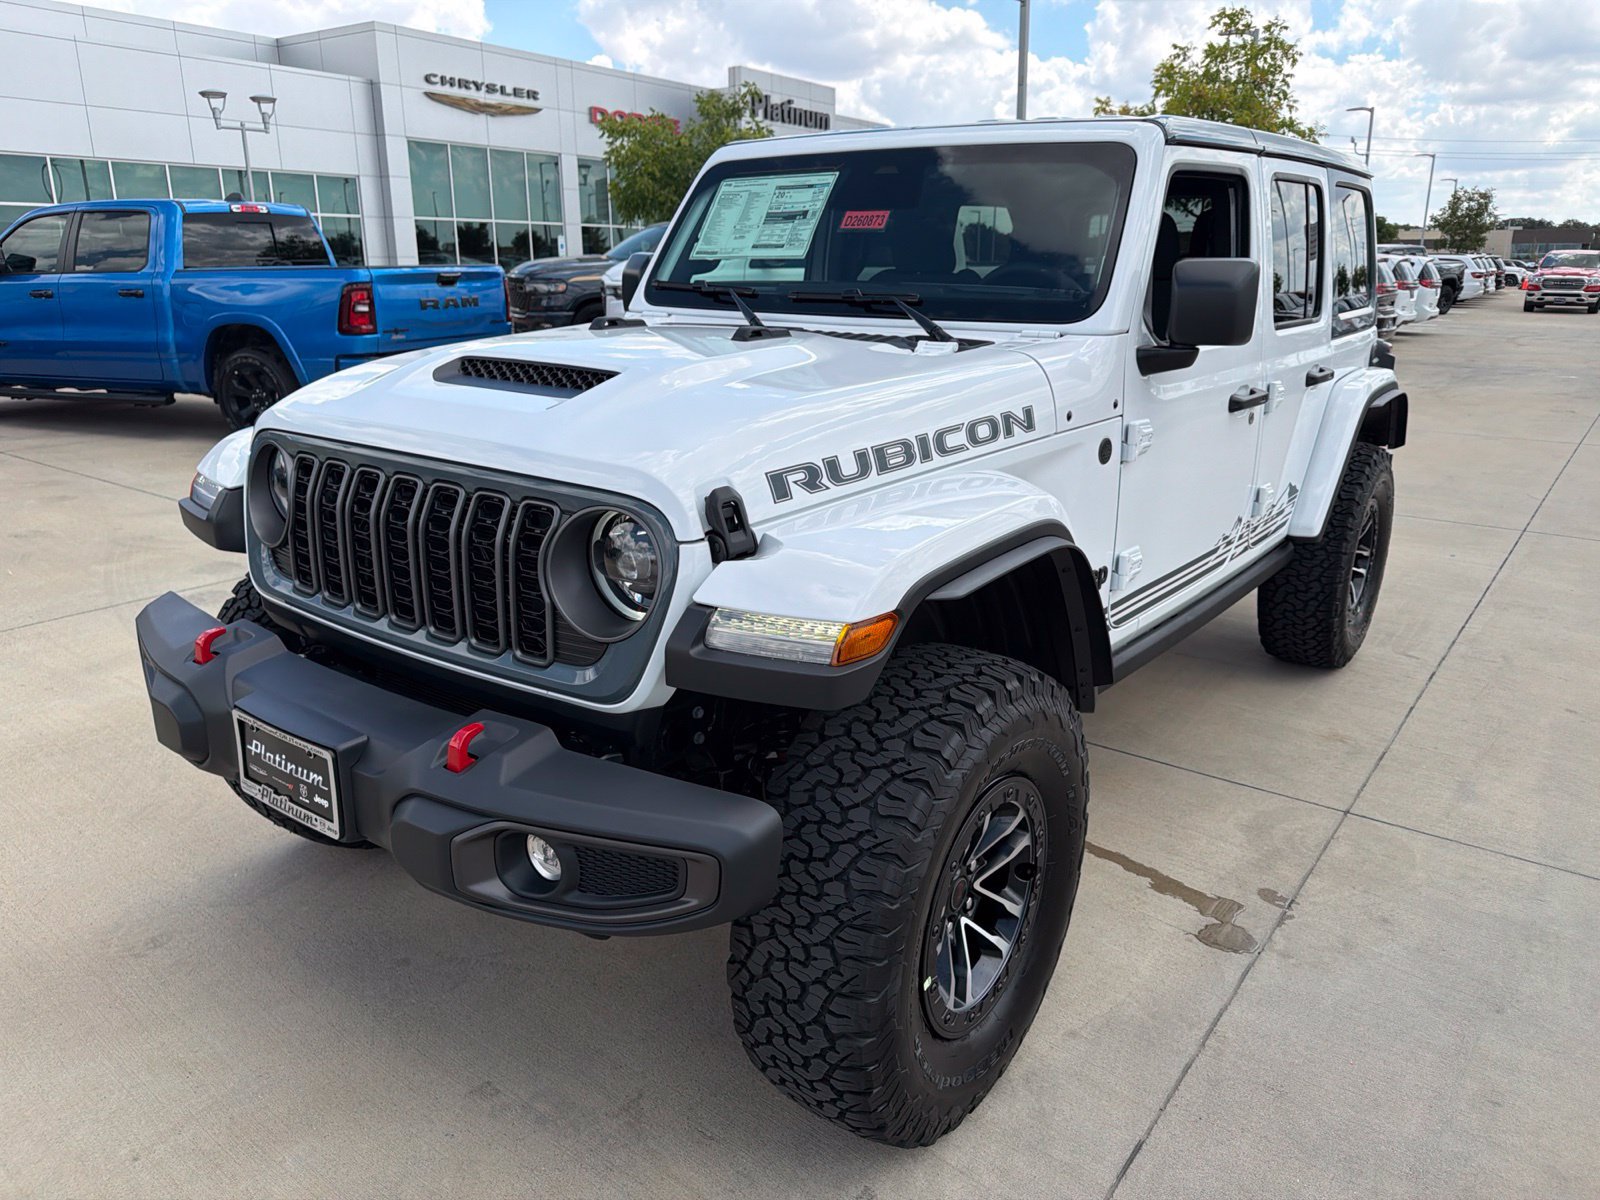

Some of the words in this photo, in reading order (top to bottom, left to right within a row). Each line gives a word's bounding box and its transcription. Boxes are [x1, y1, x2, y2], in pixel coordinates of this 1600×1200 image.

[424, 73, 540, 101] CHRYSLER
[589, 106, 680, 135] DOE
[751, 94, 830, 130] Platinum
[843, 214, 886, 228] D260873
[420, 296, 479, 311] RAM
[765, 405, 1036, 504] RUBICON
[246, 738, 329, 791] Platinum
[260, 785, 318, 827] Platinum
[313, 793, 329, 808] Jeep
